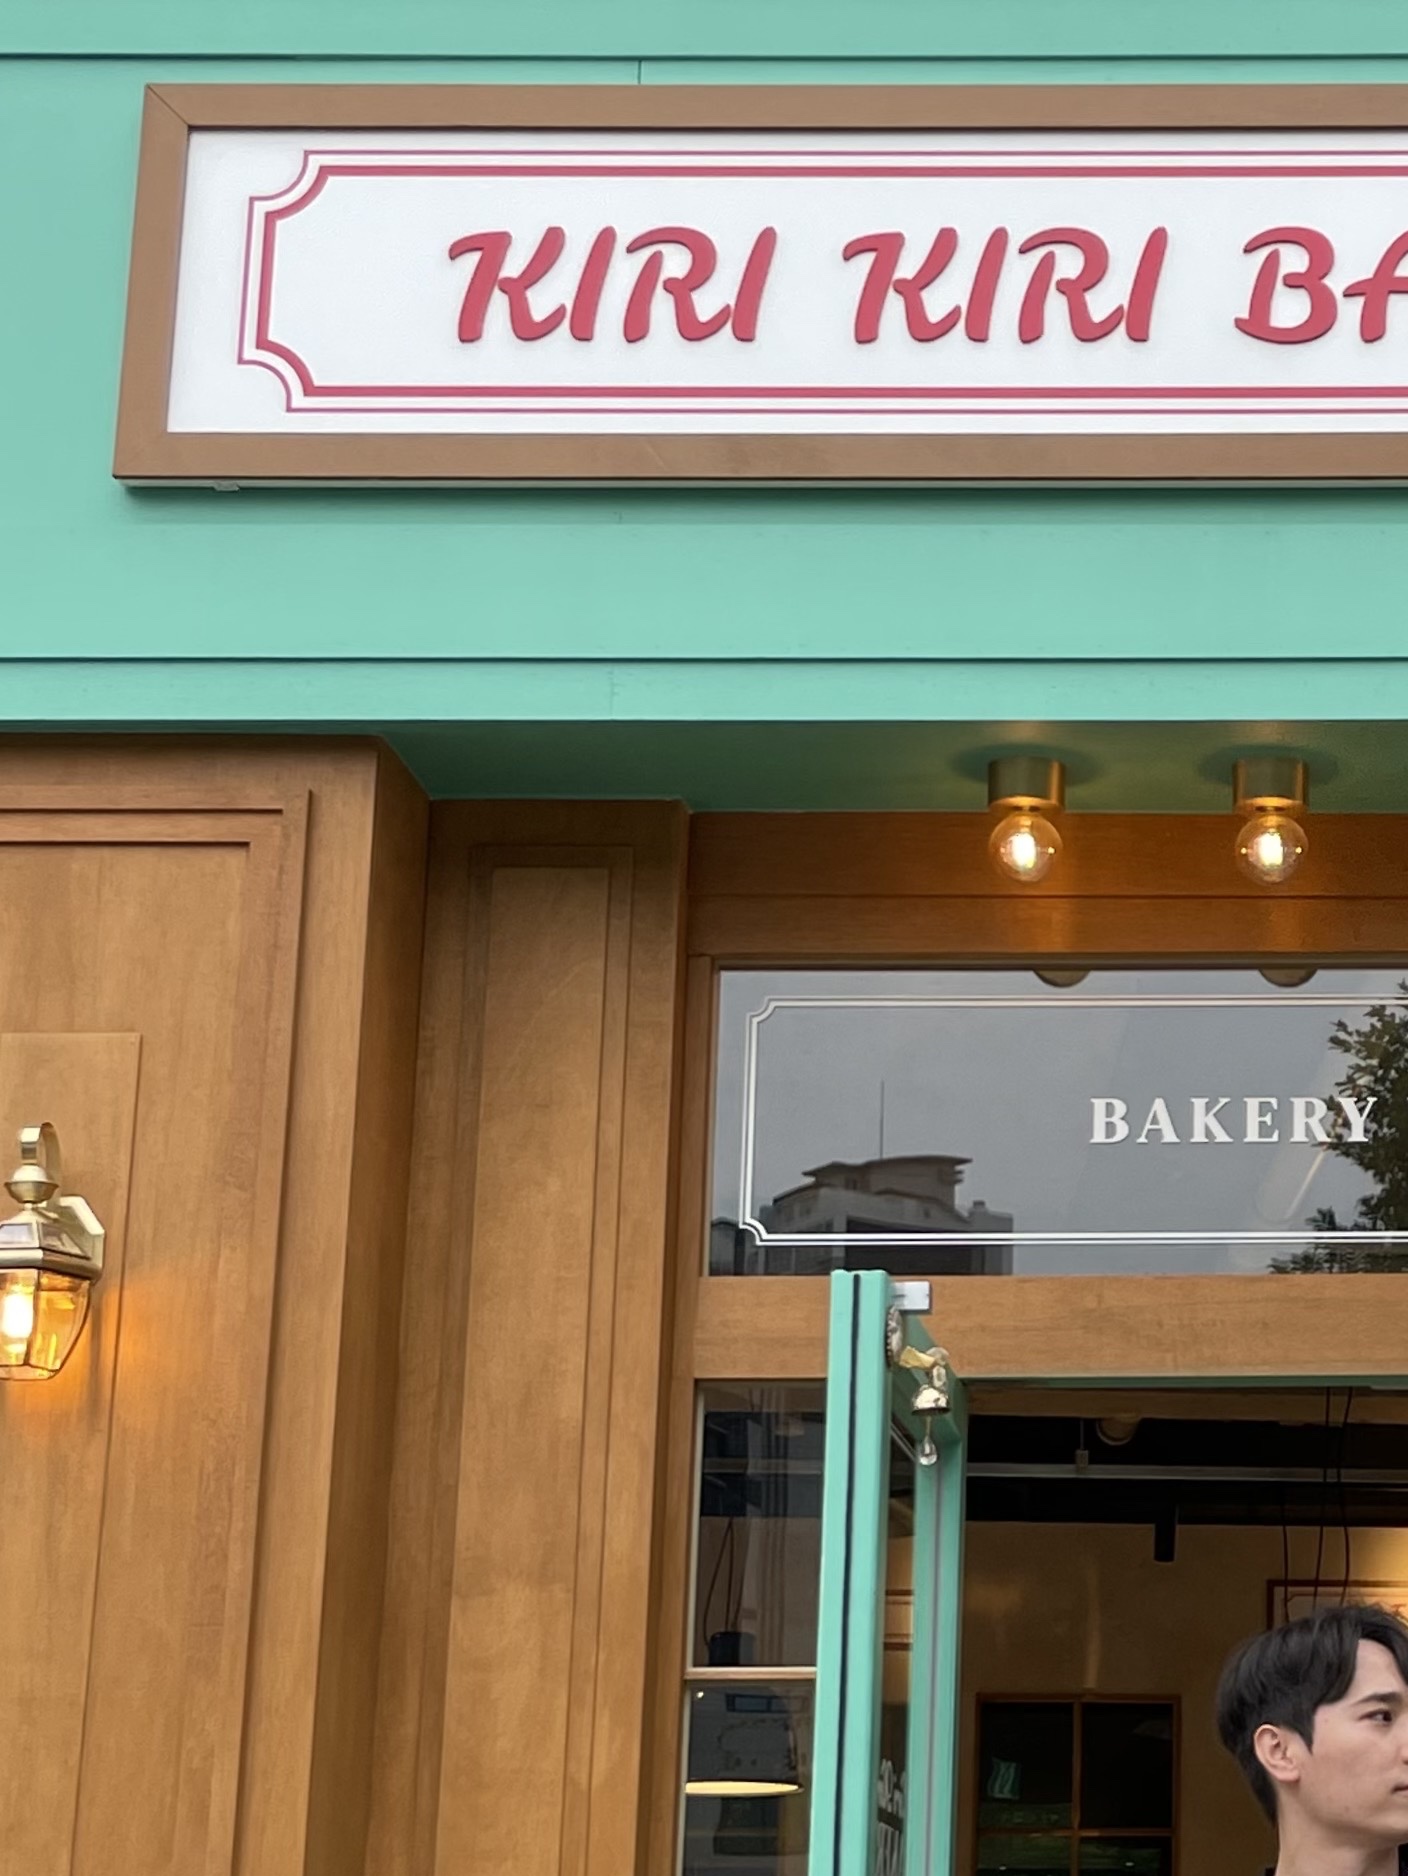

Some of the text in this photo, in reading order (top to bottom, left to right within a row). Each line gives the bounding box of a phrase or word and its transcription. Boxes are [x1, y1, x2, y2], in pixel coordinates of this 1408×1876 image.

[449, 226, 776, 344] KIRI
[843, 226, 1168, 344] KIRI
[1087, 1096, 1378, 1145] BAKERY
